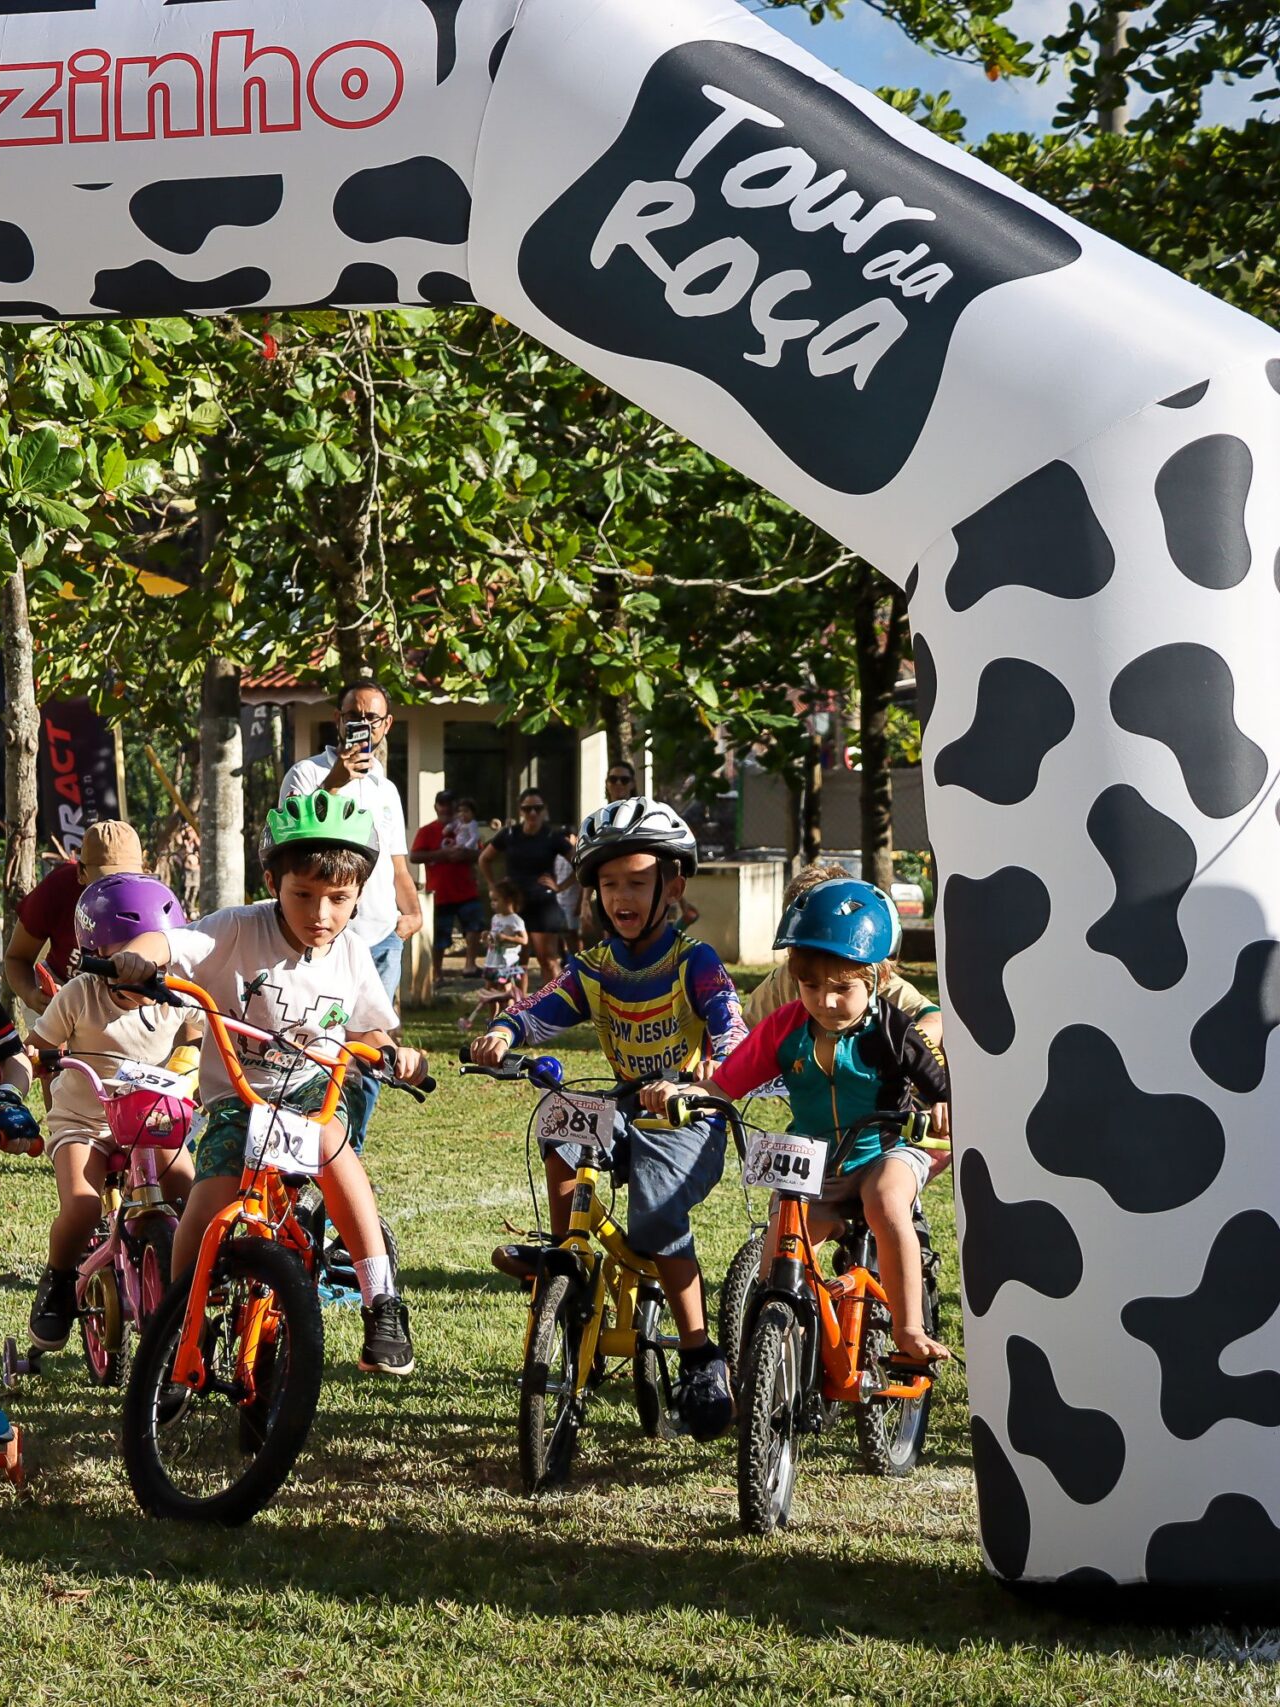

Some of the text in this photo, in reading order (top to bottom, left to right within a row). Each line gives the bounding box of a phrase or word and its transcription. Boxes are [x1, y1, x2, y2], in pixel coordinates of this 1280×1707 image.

[675, 84, 954, 303] Tour da
[761, 1140, 816, 1156] Tourzinho
